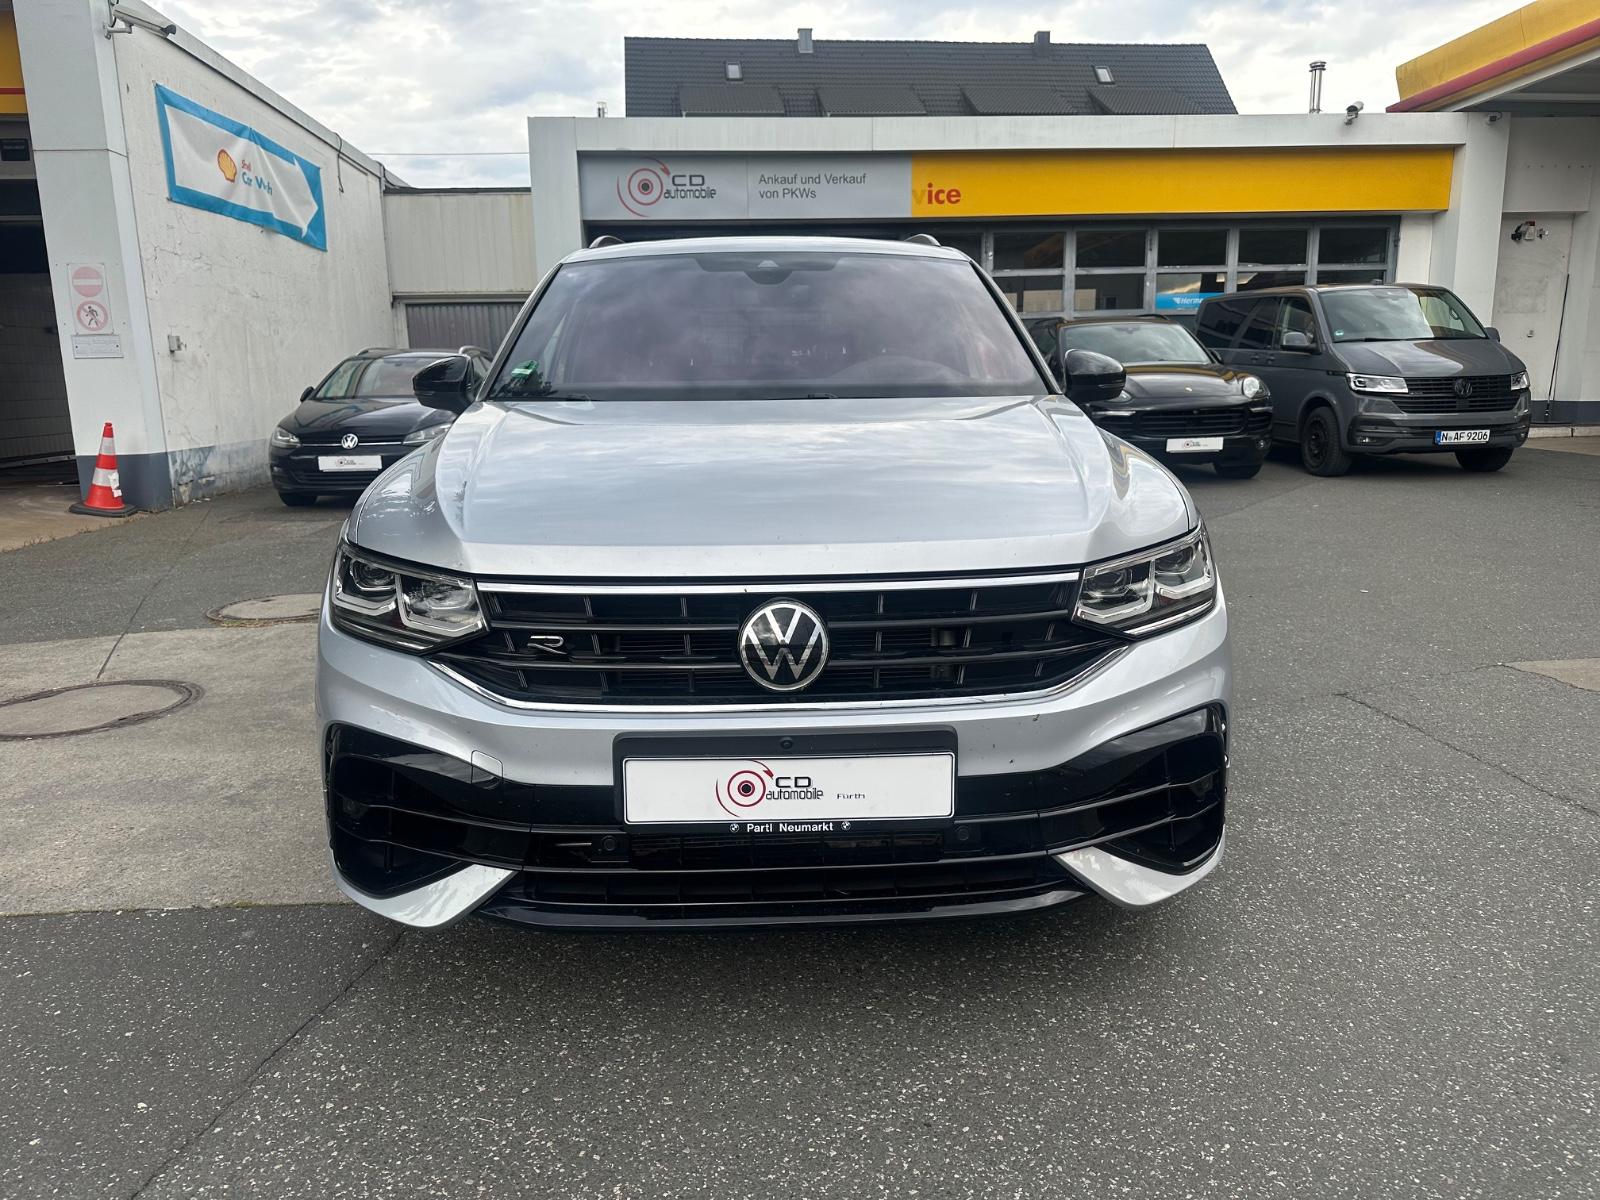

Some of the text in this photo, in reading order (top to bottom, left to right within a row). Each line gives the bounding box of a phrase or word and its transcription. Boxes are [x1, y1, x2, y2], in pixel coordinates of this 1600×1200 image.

[672, 174, 705, 187] CD
[758, 172, 867, 185] Ankauf und Verkauf
[663, 186, 717, 199] automobile
[758, 187, 817, 199] von PKWs
[1441, 431, 1488, 442] N AF 9206
[775, 776, 812, 788] CD
[765, 788, 824, 800] automobile
[779, 822, 834, 833] Neumarkt
